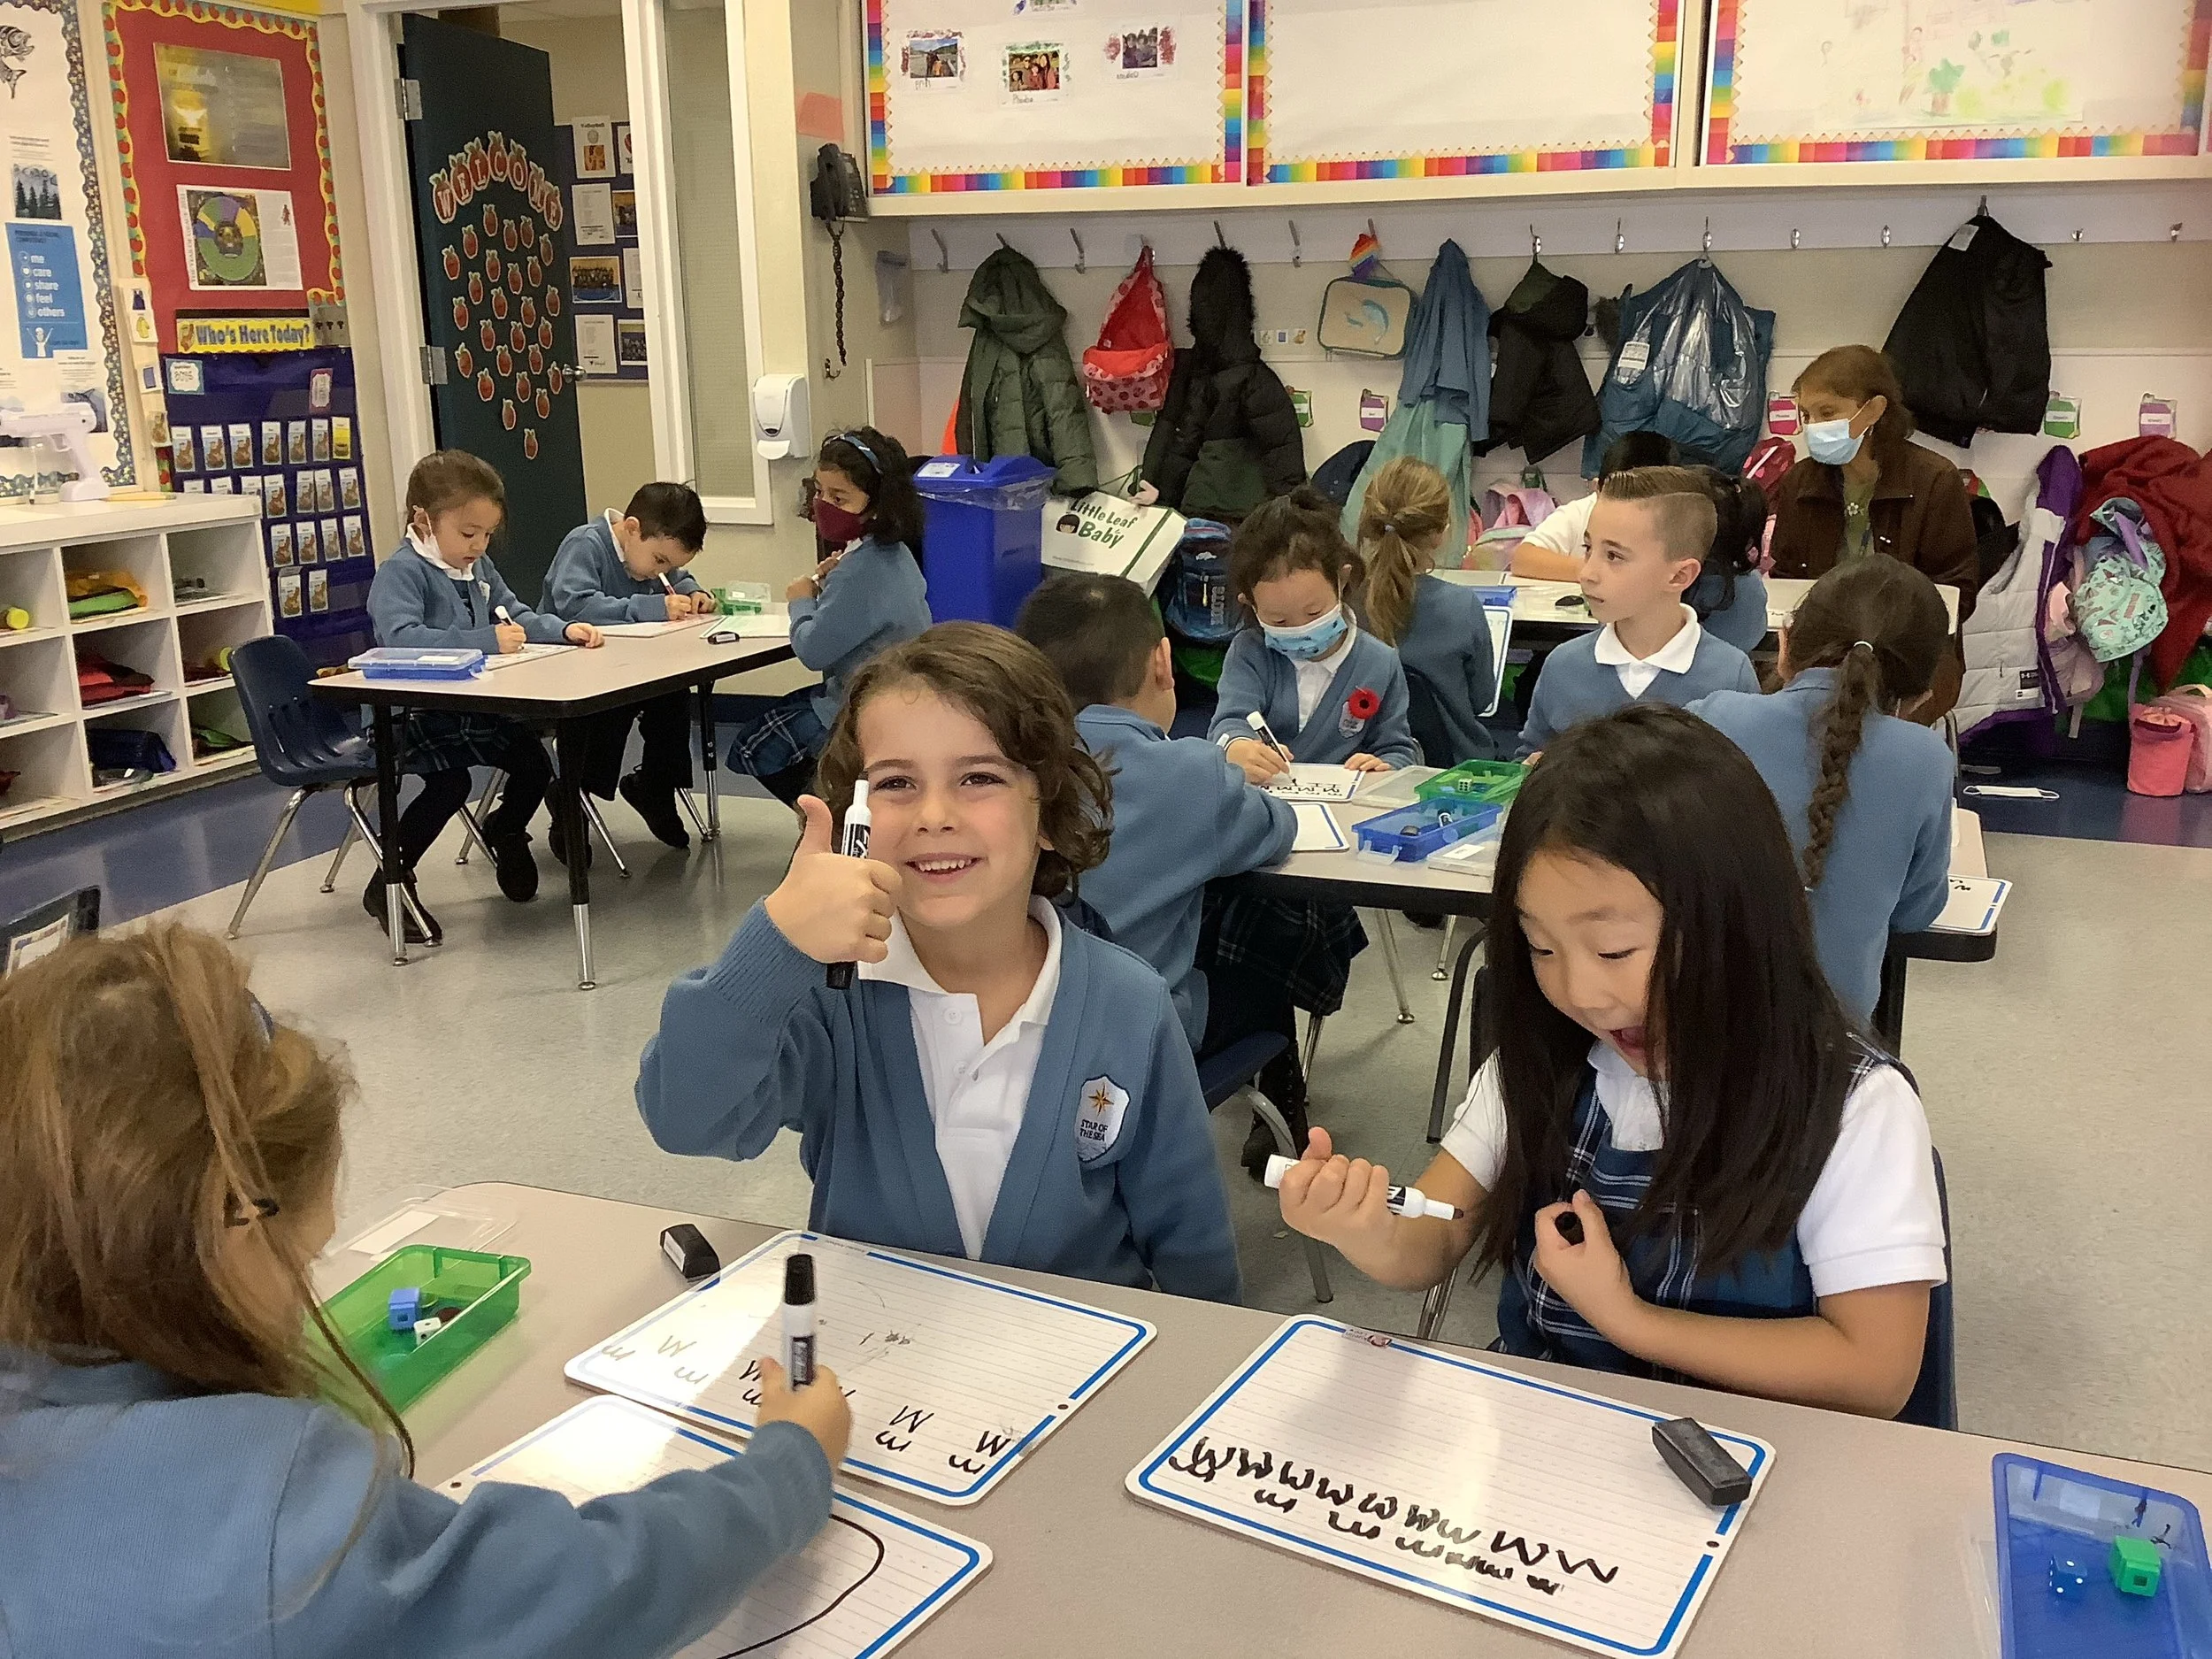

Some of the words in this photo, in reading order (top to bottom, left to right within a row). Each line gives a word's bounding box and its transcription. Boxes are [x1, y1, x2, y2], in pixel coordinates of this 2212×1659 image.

[35, 280, 59, 291] share
[35, 293, 53, 303] feel
[196, 325, 236, 345] Who's
[239, 324, 270, 344] Here
[270, 323, 310, 347] Today?
[1071, 499, 1106, 521] Little
[1106, 511, 1139, 529] Leaf
[1078, 521, 1125, 549] Baby
[1080, 1119, 1098, 1130] STAR
[1098, 1124, 1109, 1133] OF
[1079, 1128, 1093, 1139] THE
[1093, 1132, 1105, 1142] SEA
